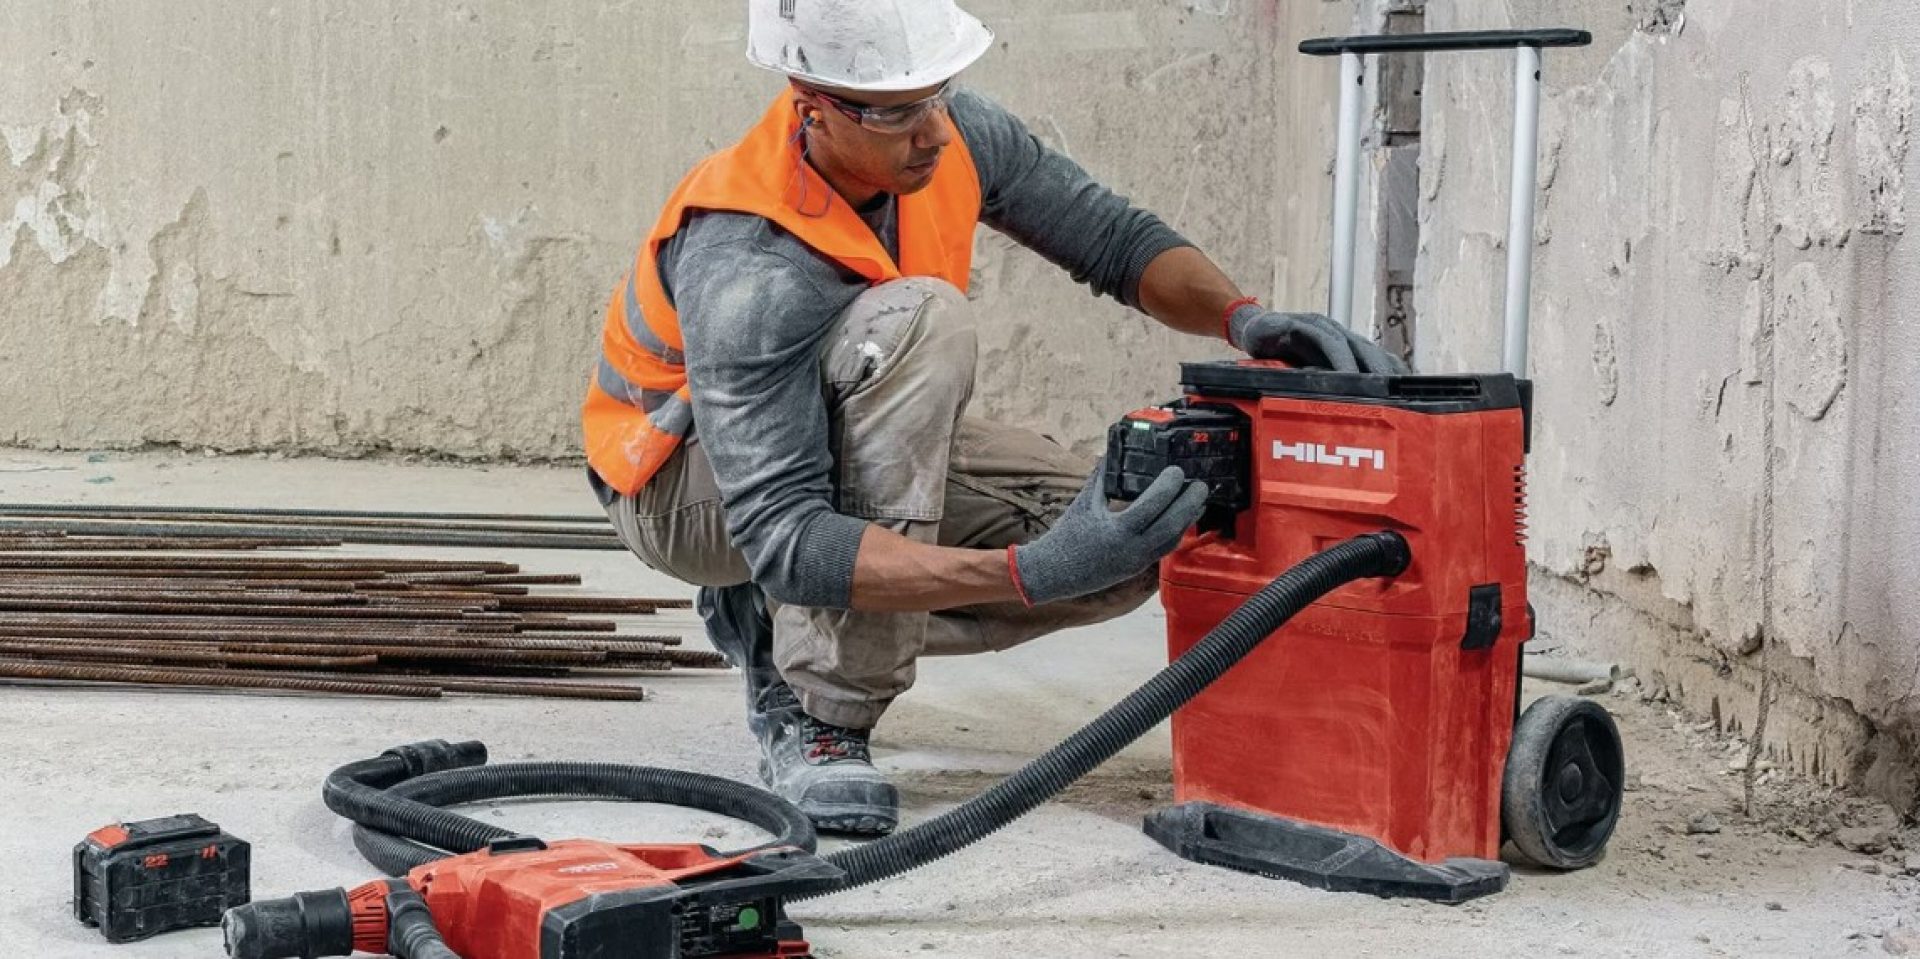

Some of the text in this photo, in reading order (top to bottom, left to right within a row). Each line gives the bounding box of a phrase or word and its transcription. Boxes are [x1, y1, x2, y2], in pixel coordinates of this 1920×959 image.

[1193, 432, 1208, 443] 22
[1272, 439, 1385, 470] HILTI
[145, 854, 169, 868] 22
